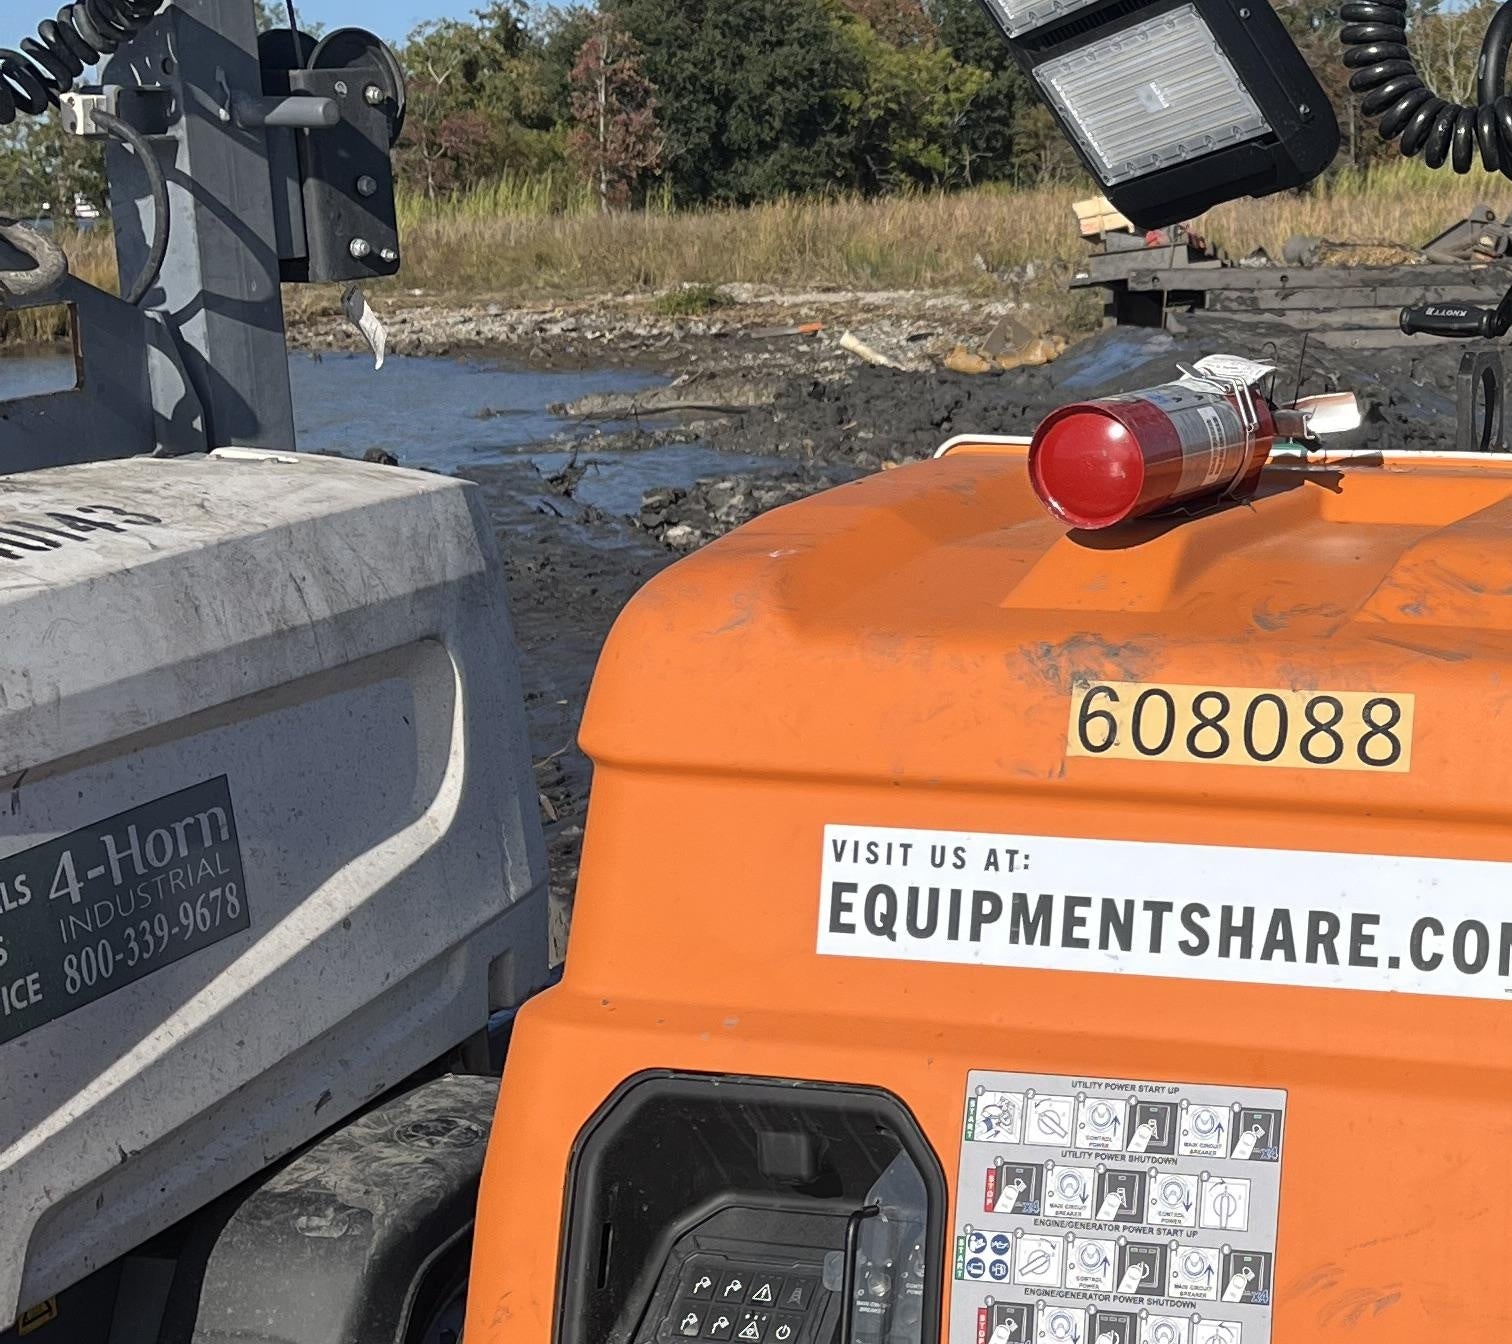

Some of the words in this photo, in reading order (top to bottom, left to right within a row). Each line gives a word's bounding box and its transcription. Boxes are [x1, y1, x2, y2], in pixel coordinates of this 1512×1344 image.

[1078, 685, 1401, 767] 608088
[50, 806, 230, 905] 4-Horn
[832, 839, 913, 867] VISIT
[930, 845, 967, 870] US
[984, 848, 1030, 873] AT:
[60, 852, 230, 944] INDUSTRIAL
[63, 882, 240, 994] 800-339-9678
[1072, 1080, 1102, 1090] UTILITY
[1104, 1082, 1136, 1093] POWER
[1138, 1084, 1165, 1094] START
[1167, 1086, 1180, 1095] UP
[967, 1099, 976, 1139] START
[1061, 1151, 1093, 1160] UTILITY
[1095, 1152, 1127, 1163] POWER
[1128, 1155, 1178, 1166] SHUTDOWN
[1033, 1219, 1120, 1232] ENGINE/GENERATOR
[1122, 1224, 1154, 1235] POWER
[1156, 1227, 1185, 1237] START
[1186, 1230, 1199, 1238] UP
[956, 1238, 965, 1278] START
[1024, 1288, 1110, 1302] ENGINE/GENERATOR
[1112, 1294, 1144, 1305] POWER
[1146, 1297, 1197, 1309] SHUTDOWN
